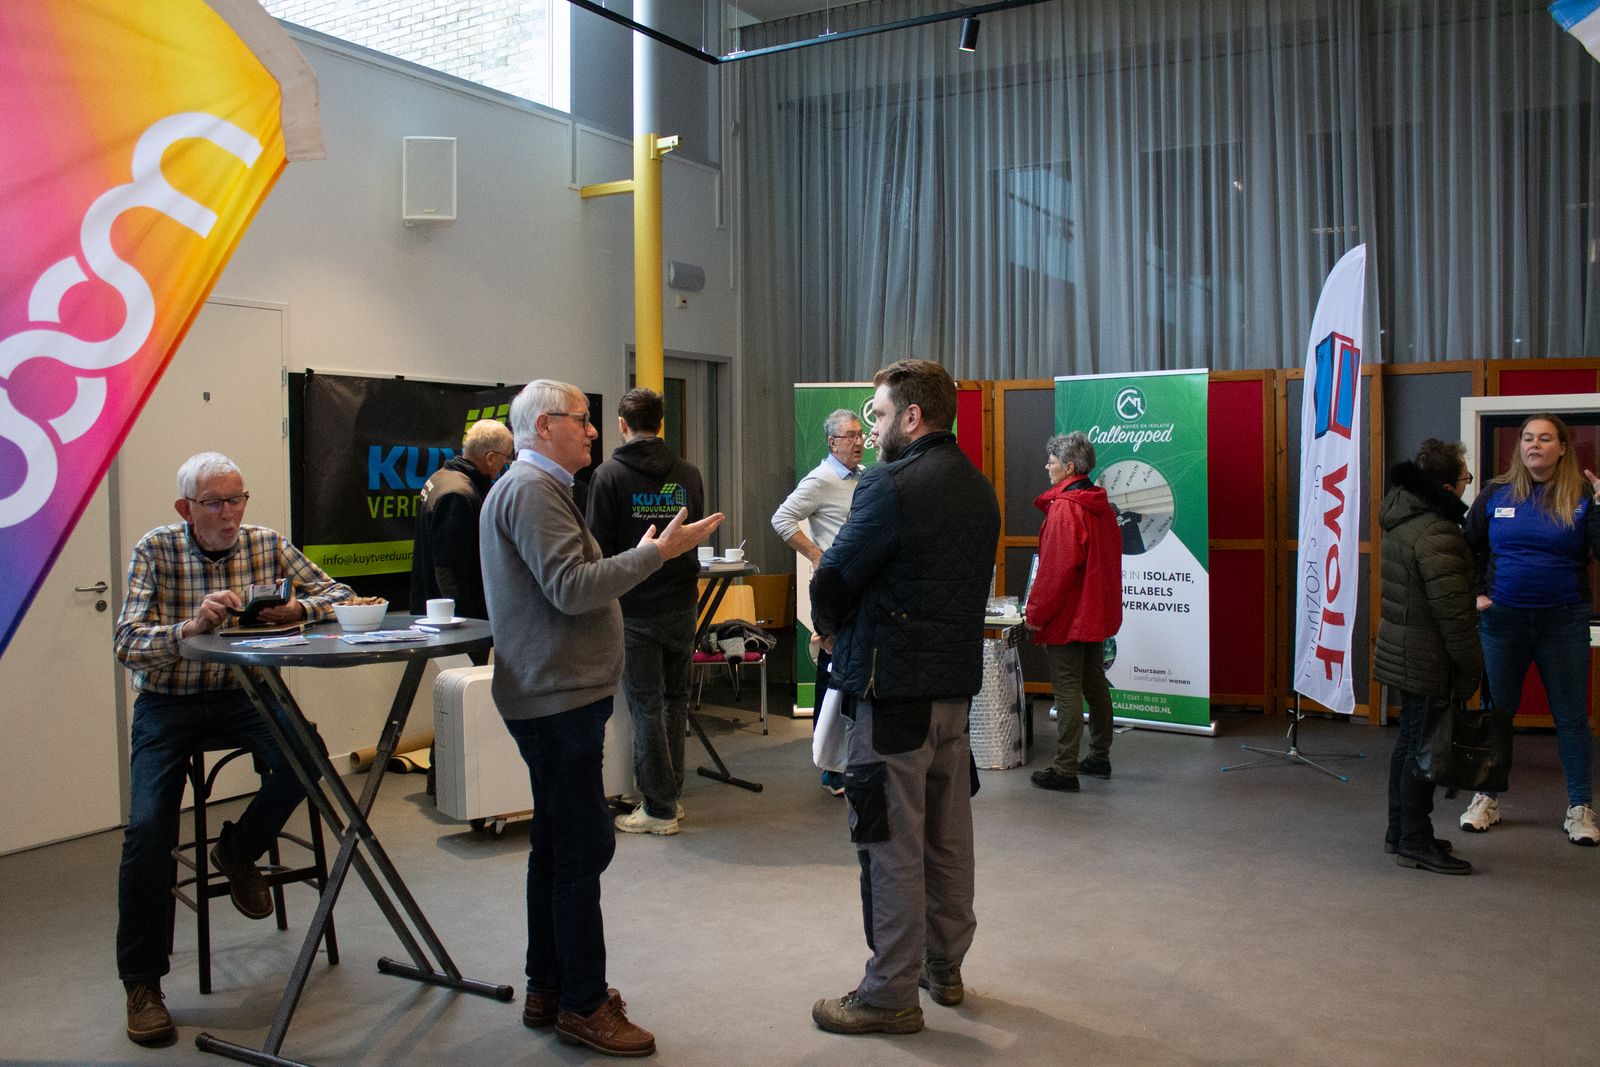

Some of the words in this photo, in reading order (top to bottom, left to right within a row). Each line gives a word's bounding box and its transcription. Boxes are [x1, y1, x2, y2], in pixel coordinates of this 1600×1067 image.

[1087, 423, 1174, 453] Callengoed
[632, 493, 671, 506] KUYT
[1130, 571, 1140, 580] IN
[1143, 571, 1194, 584] ISOLATIE,
[1316, 463, 1349, 688] WOLF
[1122, 586, 1173, 597] IELABELS
[1133, 666, 1166, 675] Duurzaam
